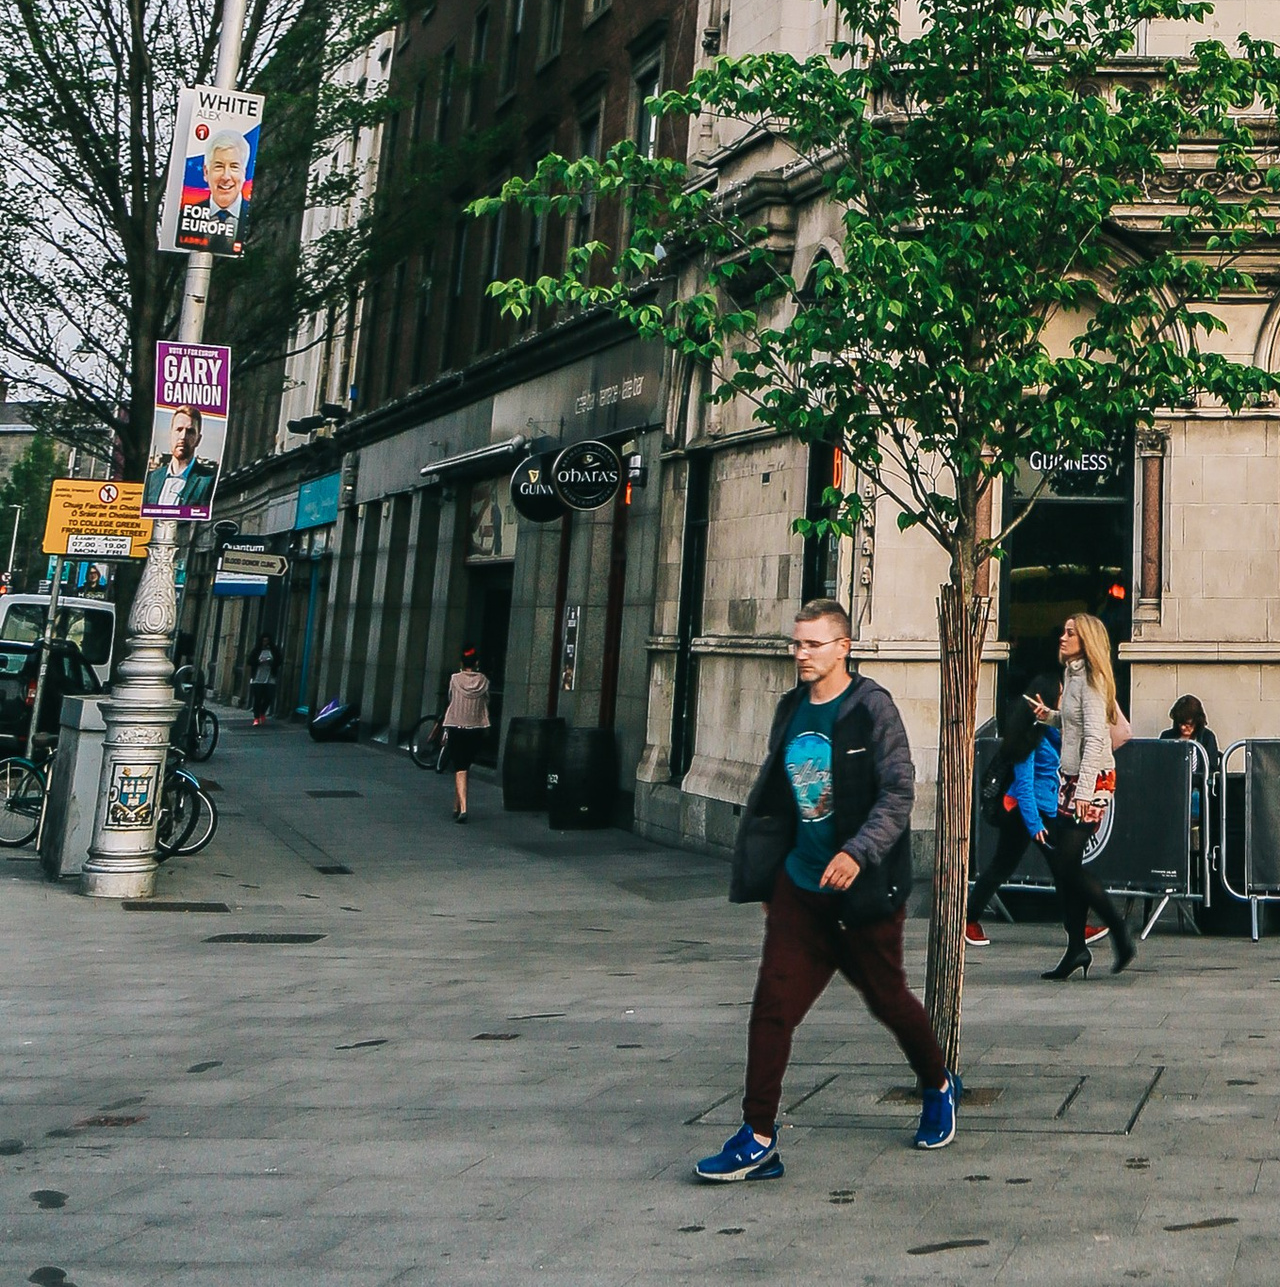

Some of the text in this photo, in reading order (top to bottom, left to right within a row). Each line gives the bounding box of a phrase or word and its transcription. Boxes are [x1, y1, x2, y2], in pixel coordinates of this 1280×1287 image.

[199, 91, 258, 117] WHITE
[196, 109, 222, 122] ALEX
[183, 205, 210, 220] FOR
[181, 218, 234, 237] EUROPE
[164, 355, 222, 385] GARY
[163, 382, 222, 406] GANNON
[116, 521, 141, 529] GREEN
[121, 529, 147, 537] STREET
